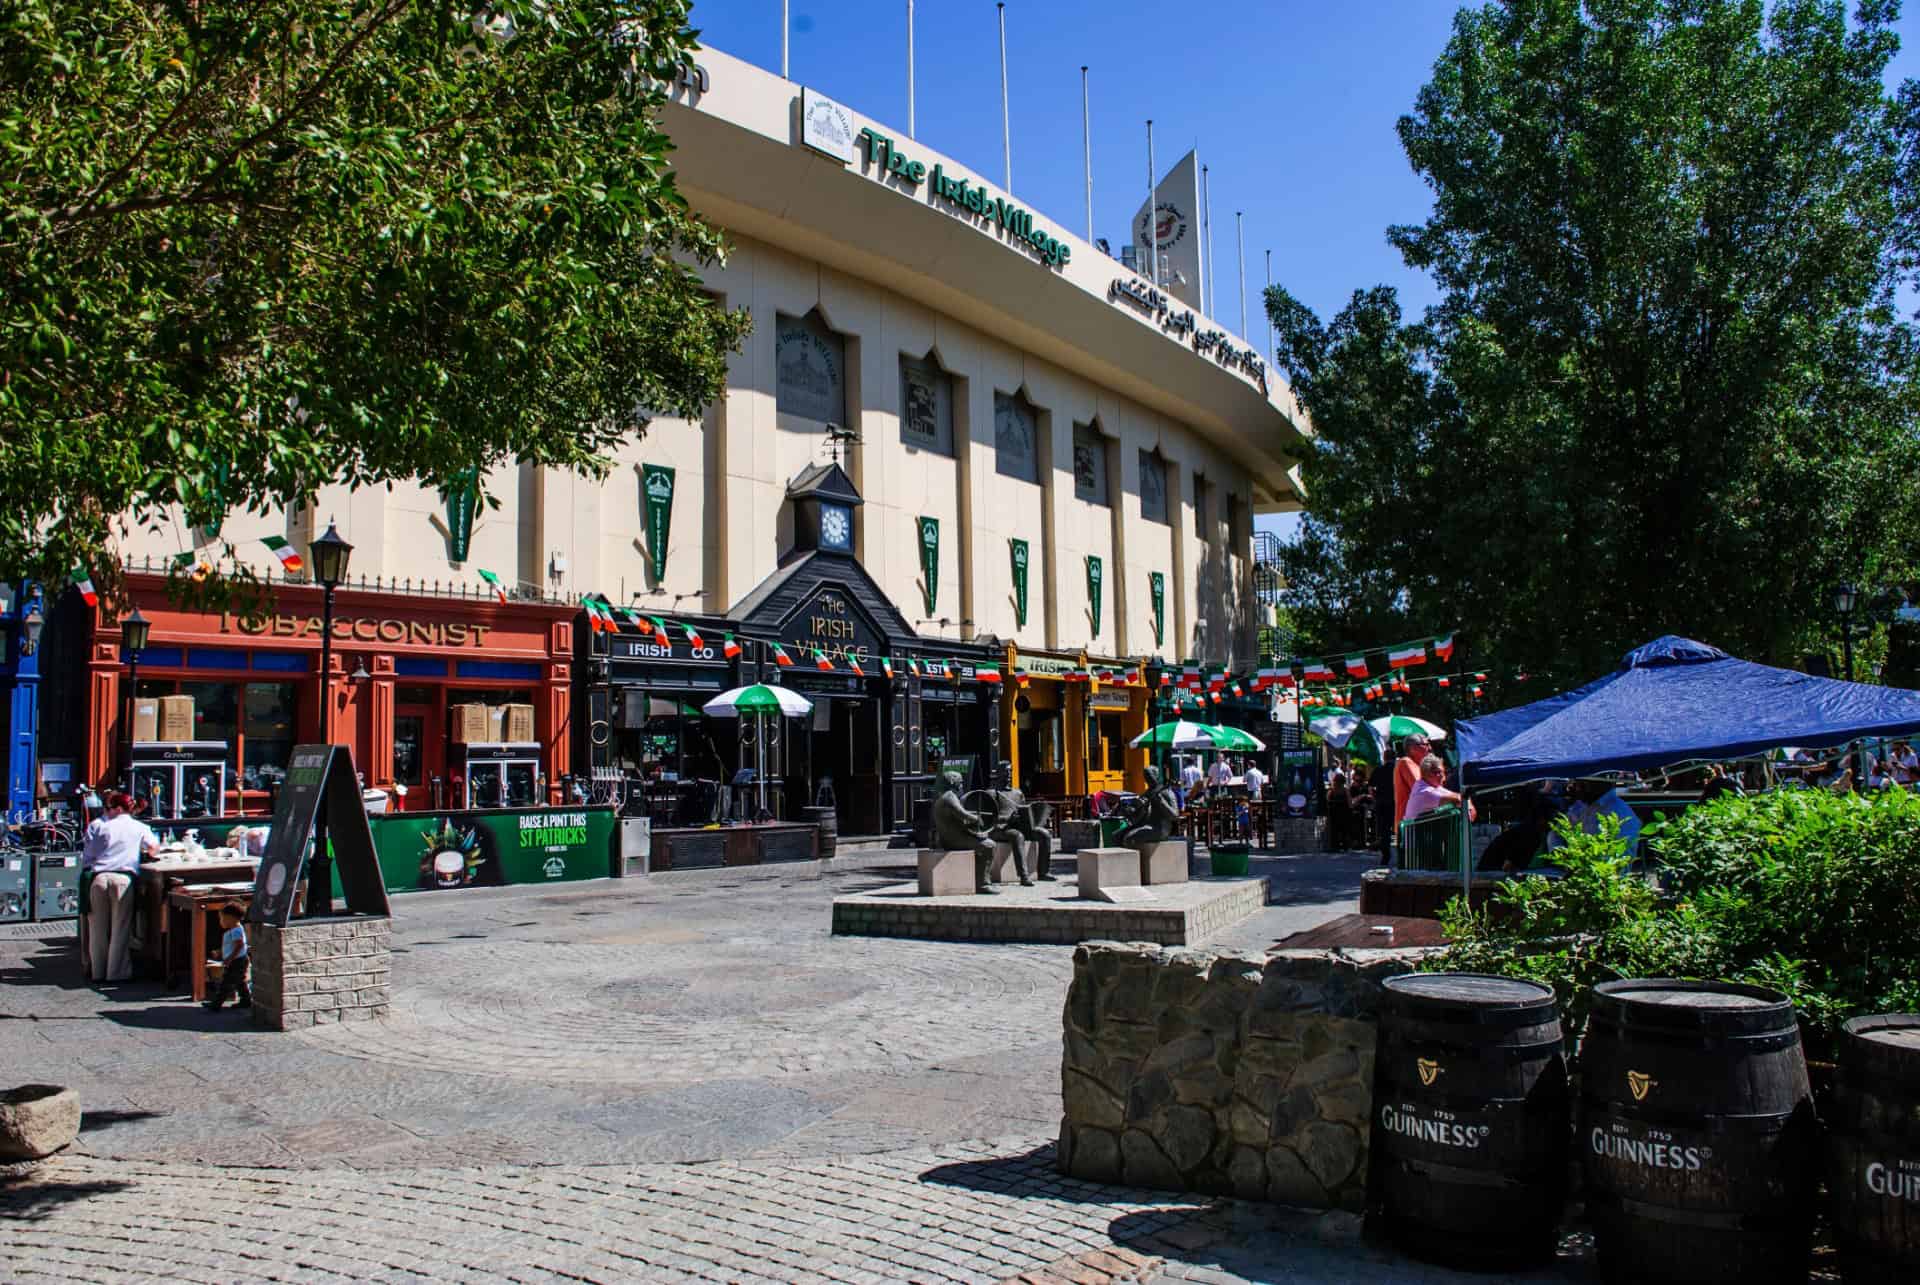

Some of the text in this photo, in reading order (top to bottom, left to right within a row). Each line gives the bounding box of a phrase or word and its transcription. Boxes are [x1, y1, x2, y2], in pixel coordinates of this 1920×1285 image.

[860, 126, 1071, 266] The Irish Village
[220, 611, 491, 647] TOBACCONIST
[810, 616, 855, 640] IRISH
[629, 643, 714, 659] IRISH CO
[519, 812, 586, 829] RAISE A PINT THIS
[520, 829, 535, 848] ST
[1381, 1104, 1479, 1149] GUINNESS
[1591, 1126, 1701, 1171] GUINNESS
